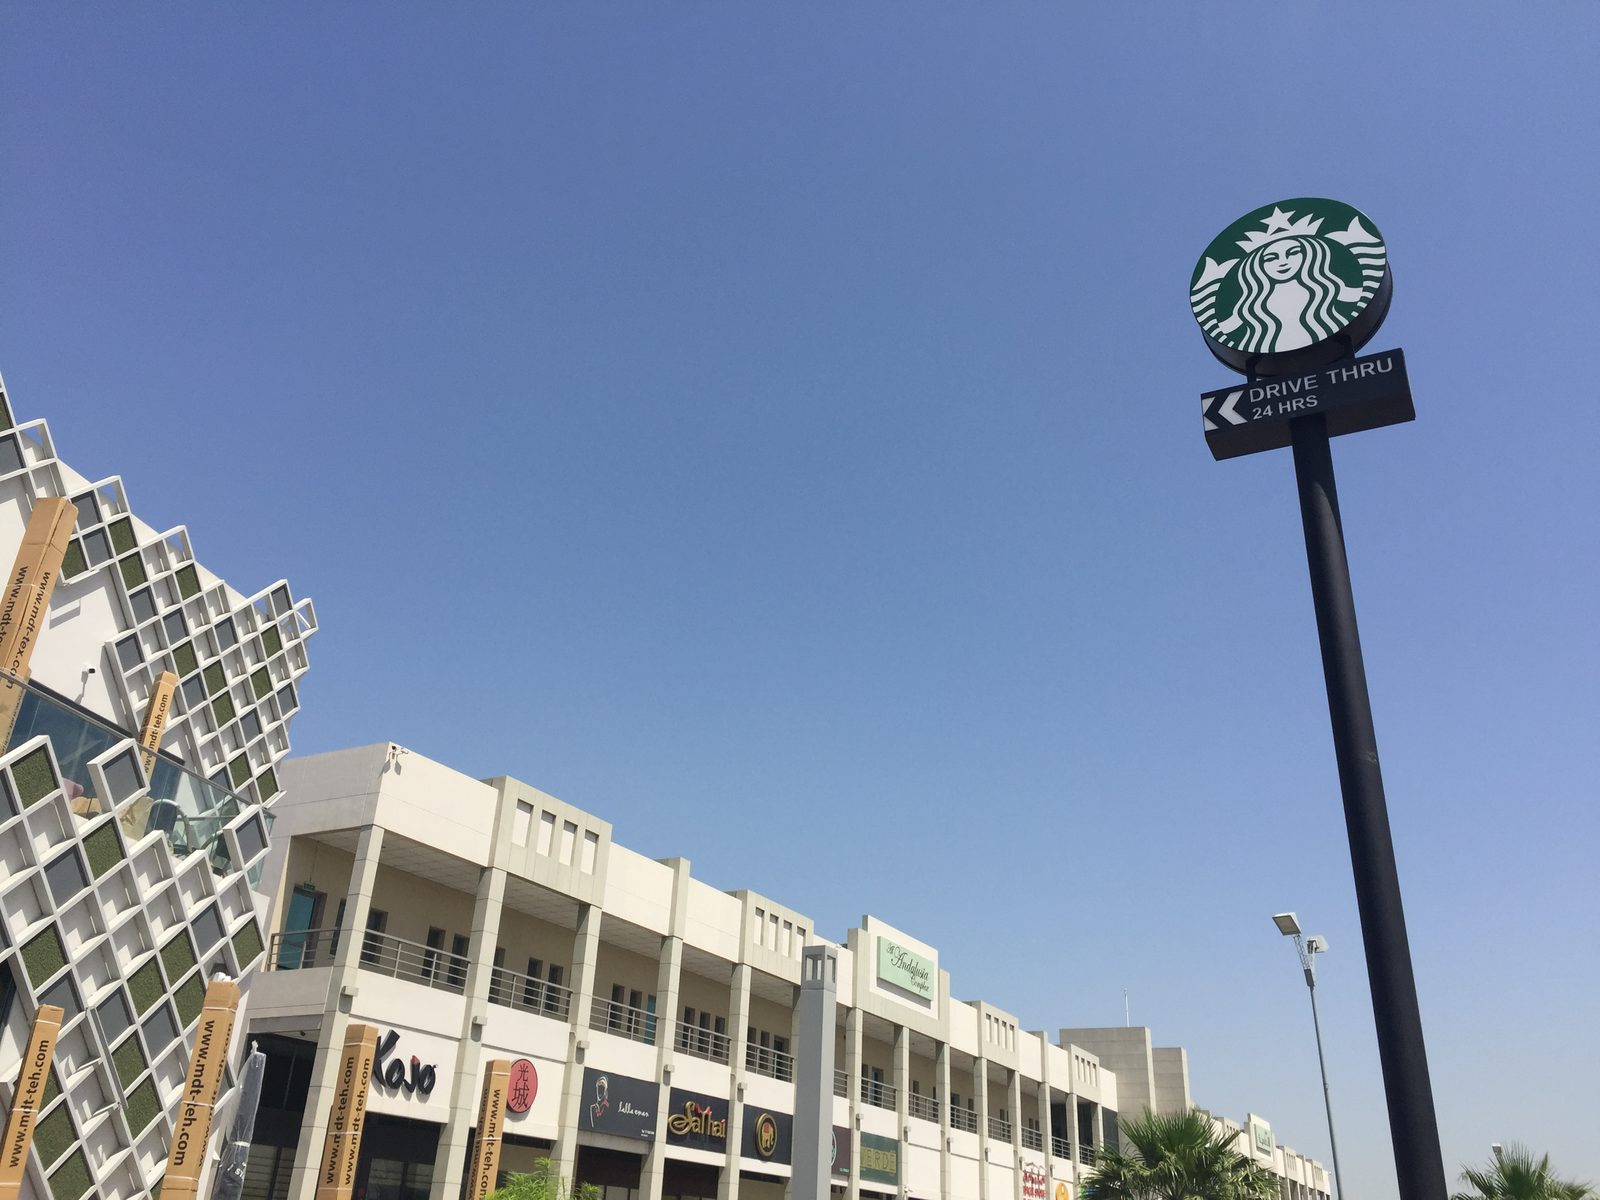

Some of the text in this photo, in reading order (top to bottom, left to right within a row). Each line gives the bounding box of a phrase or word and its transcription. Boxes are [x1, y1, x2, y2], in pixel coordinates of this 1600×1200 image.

[1249, 357, 1393, 402] DRIVE THRU
[1253, 395, 1318, 420] 24 HRS
[9, 1040, 50, 1168] www.mdt-teh.com
[173, 1020, 215, 1166] www.mdt-teh.com
[327, 1057, 355, 1184] www.mdt-teh.com
[345, 1058, 371, 1185] www.mdt-teh.com
